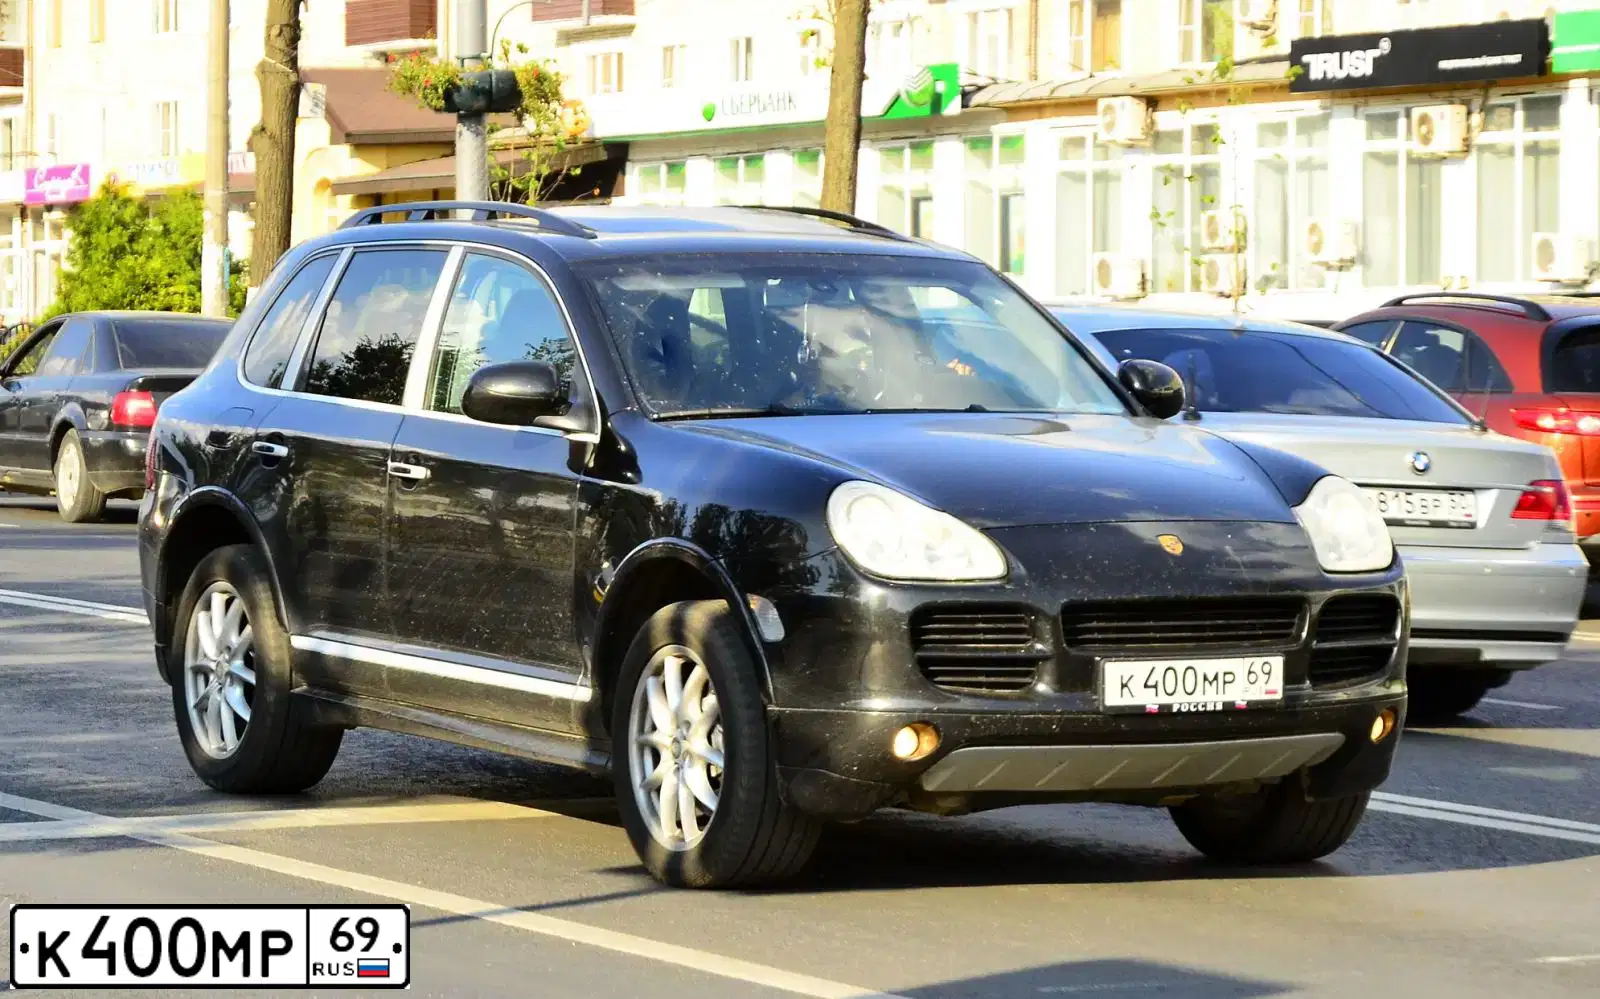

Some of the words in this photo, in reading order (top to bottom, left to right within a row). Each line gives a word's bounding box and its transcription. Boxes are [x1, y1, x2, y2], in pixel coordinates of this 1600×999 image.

[1301, 49, 1381, 80] TRUST
[721, 91, 797, 116] СБЕРБАНК
[1247, 661, 1273, 685] 69
[1172, 701, 1223, 713] РОССИЯ
